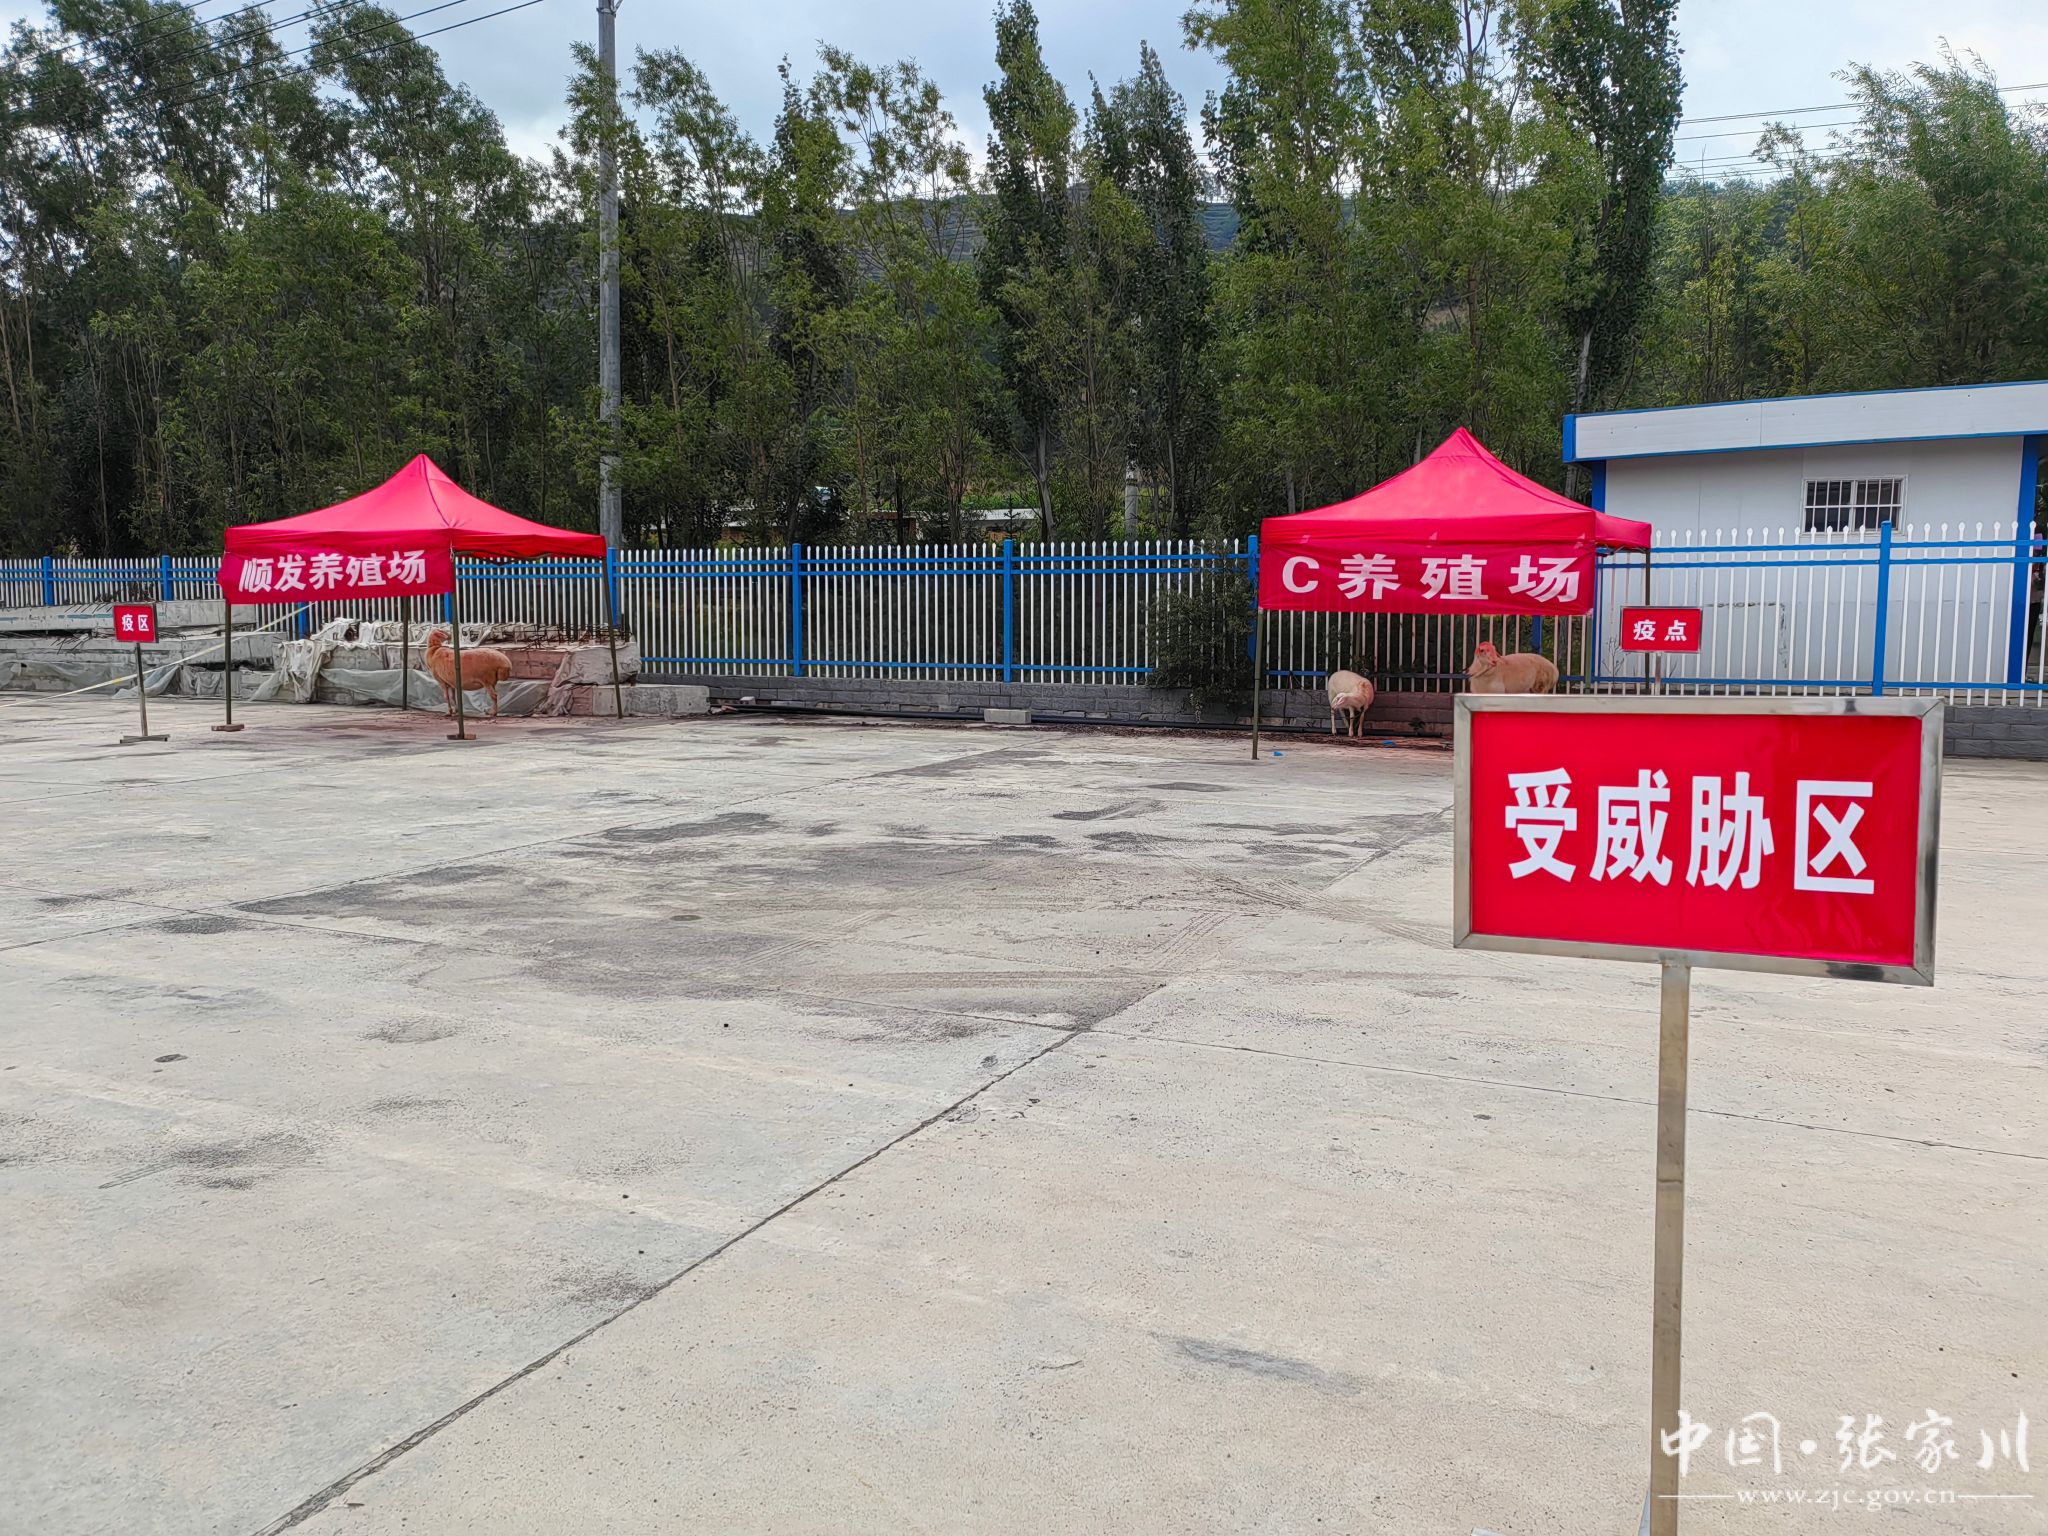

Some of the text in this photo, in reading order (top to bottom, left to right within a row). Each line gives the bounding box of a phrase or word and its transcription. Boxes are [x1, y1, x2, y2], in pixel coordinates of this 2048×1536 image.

[239, 549, 427, 593] 顺发养殖场
[121, 613, 149, 632] 疫区
[1633, 619, 1687, 642] 疫点
[1505, 767, 1875, 895] 受威胁区
